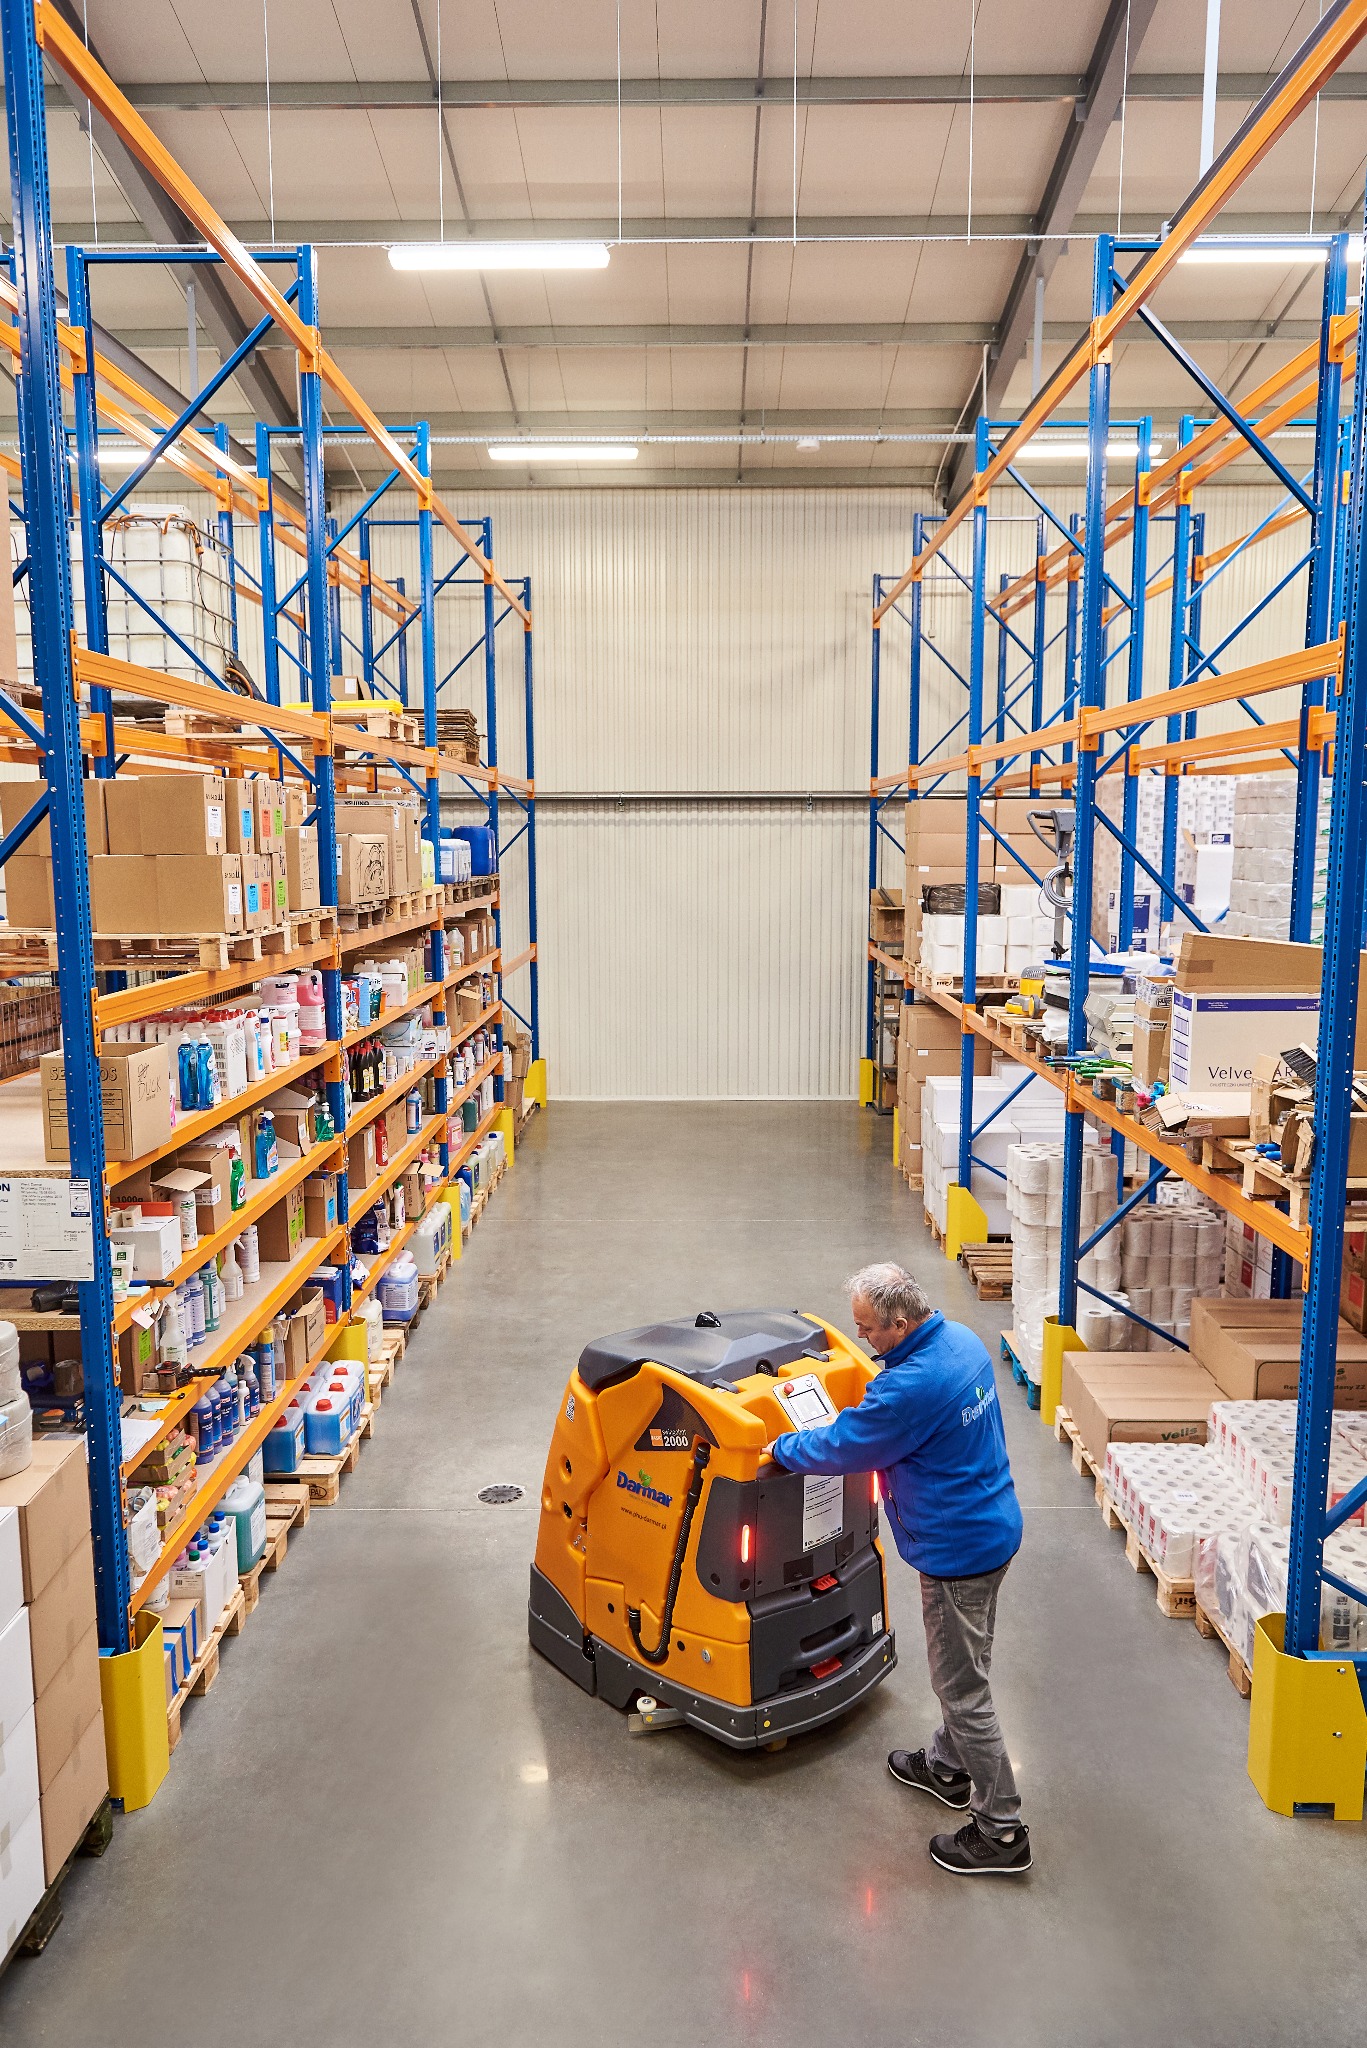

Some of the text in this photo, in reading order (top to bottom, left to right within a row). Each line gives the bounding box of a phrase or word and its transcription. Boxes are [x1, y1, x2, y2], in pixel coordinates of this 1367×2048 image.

[1208, 1066, 1253, 1080] Velve
[663, 1435, 689, 1447] 2000
[1160, 1427, 1198, 1441] Velis
[311, 1488, 323, 1496] PAL
[616, 1471, 673, 1508] Darmar
